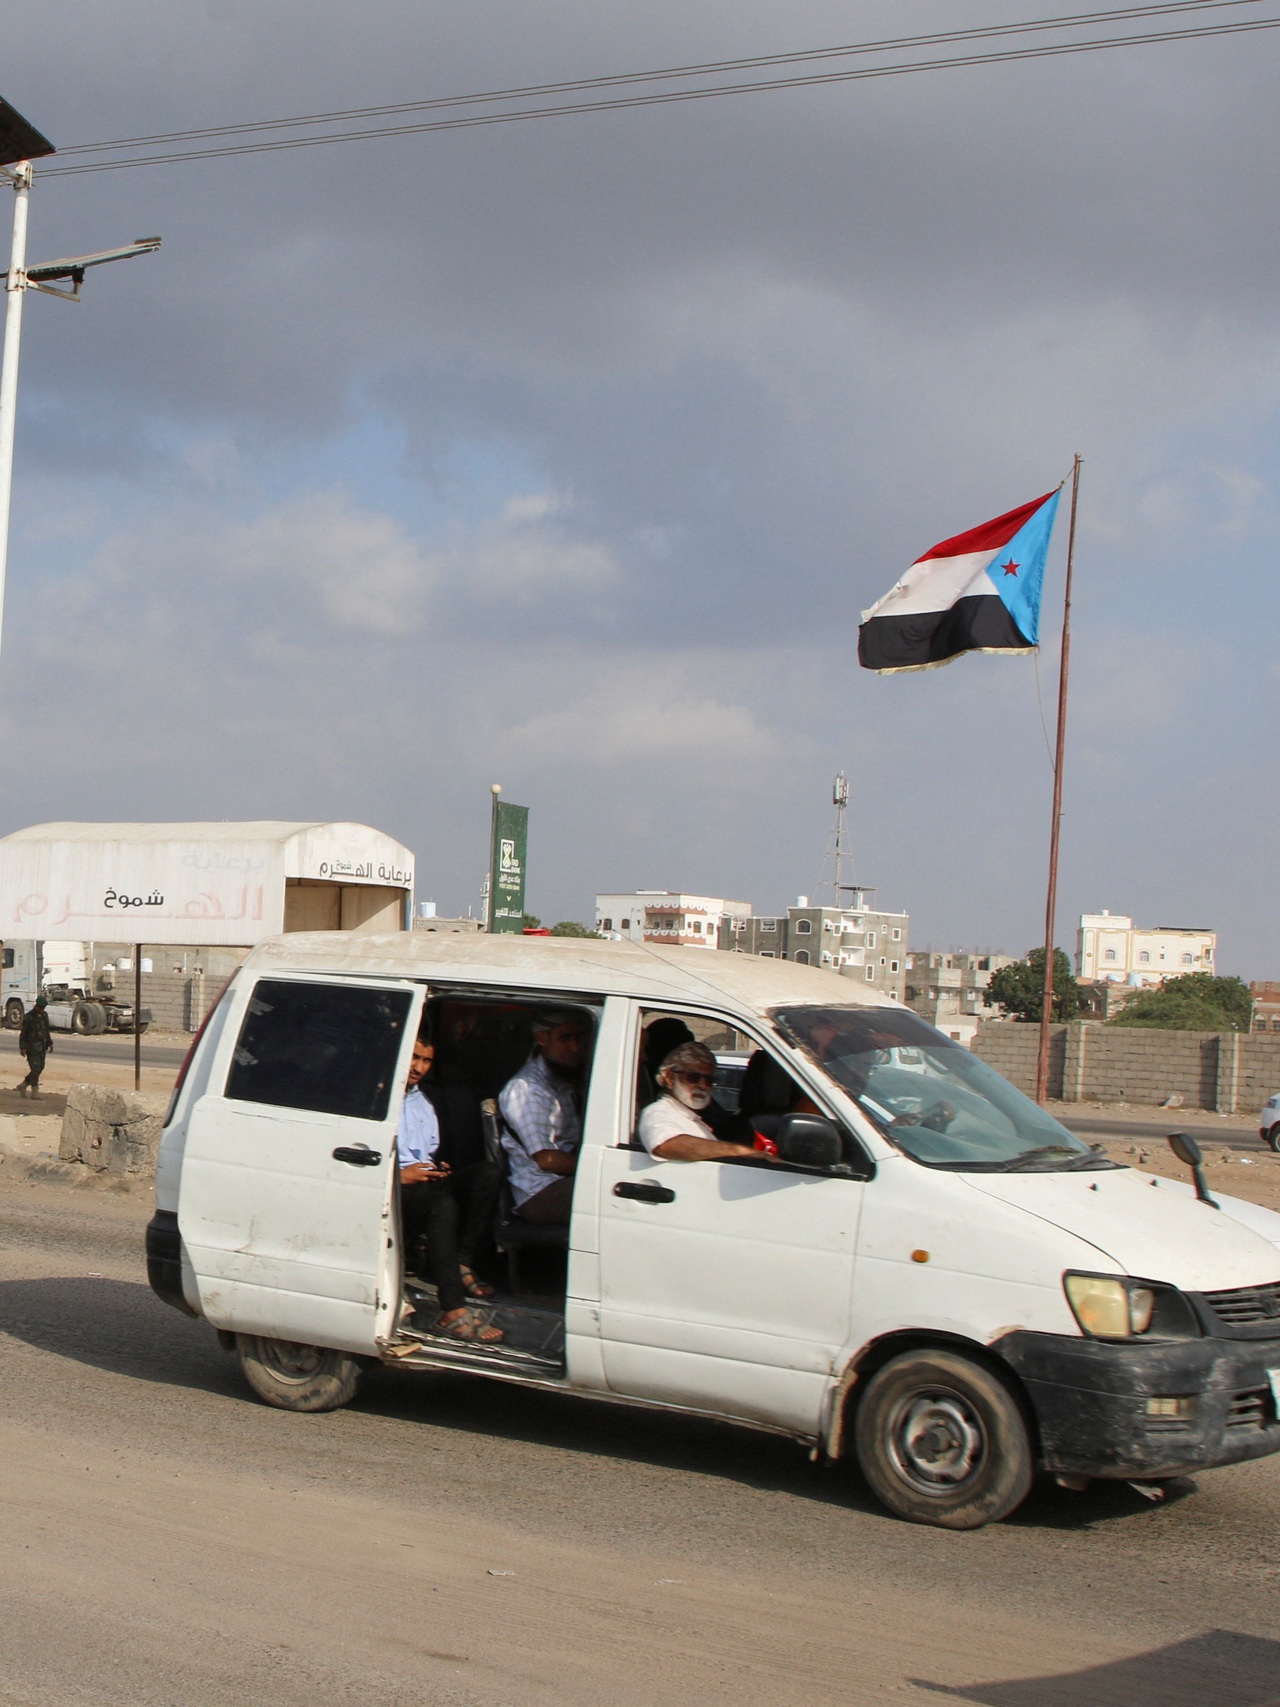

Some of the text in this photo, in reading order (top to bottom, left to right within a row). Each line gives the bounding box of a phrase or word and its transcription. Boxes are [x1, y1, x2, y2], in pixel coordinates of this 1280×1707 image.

[181, 850, 265, 874] برعاية
[320, 862, 412, 886] برعاية الهرم
[104, 886, 164, 908] شموخ
